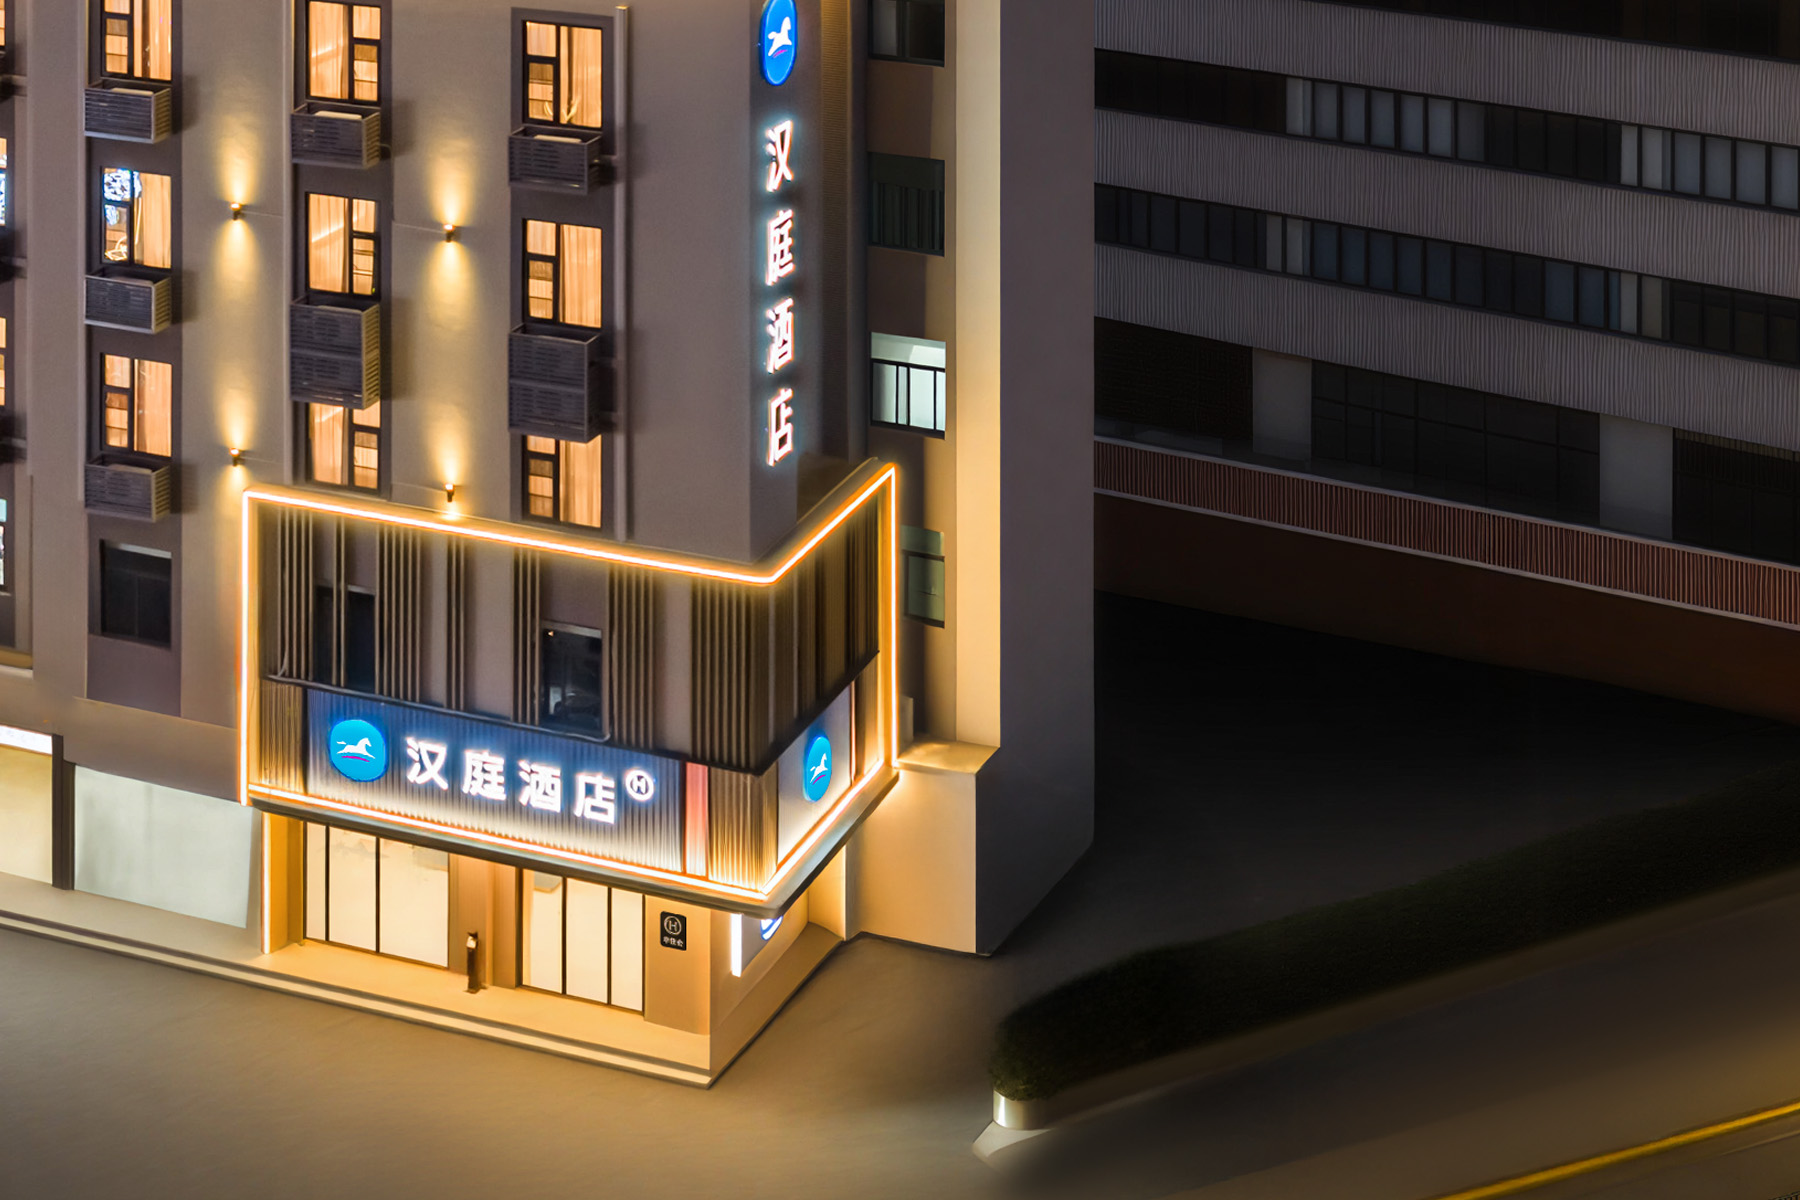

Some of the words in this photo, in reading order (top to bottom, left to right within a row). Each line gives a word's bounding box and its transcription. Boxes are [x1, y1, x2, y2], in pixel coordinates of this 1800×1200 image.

[765, 120, 795, 466] 汉庭酒店
[405, 737, 615, 824] 汉庭酒店
